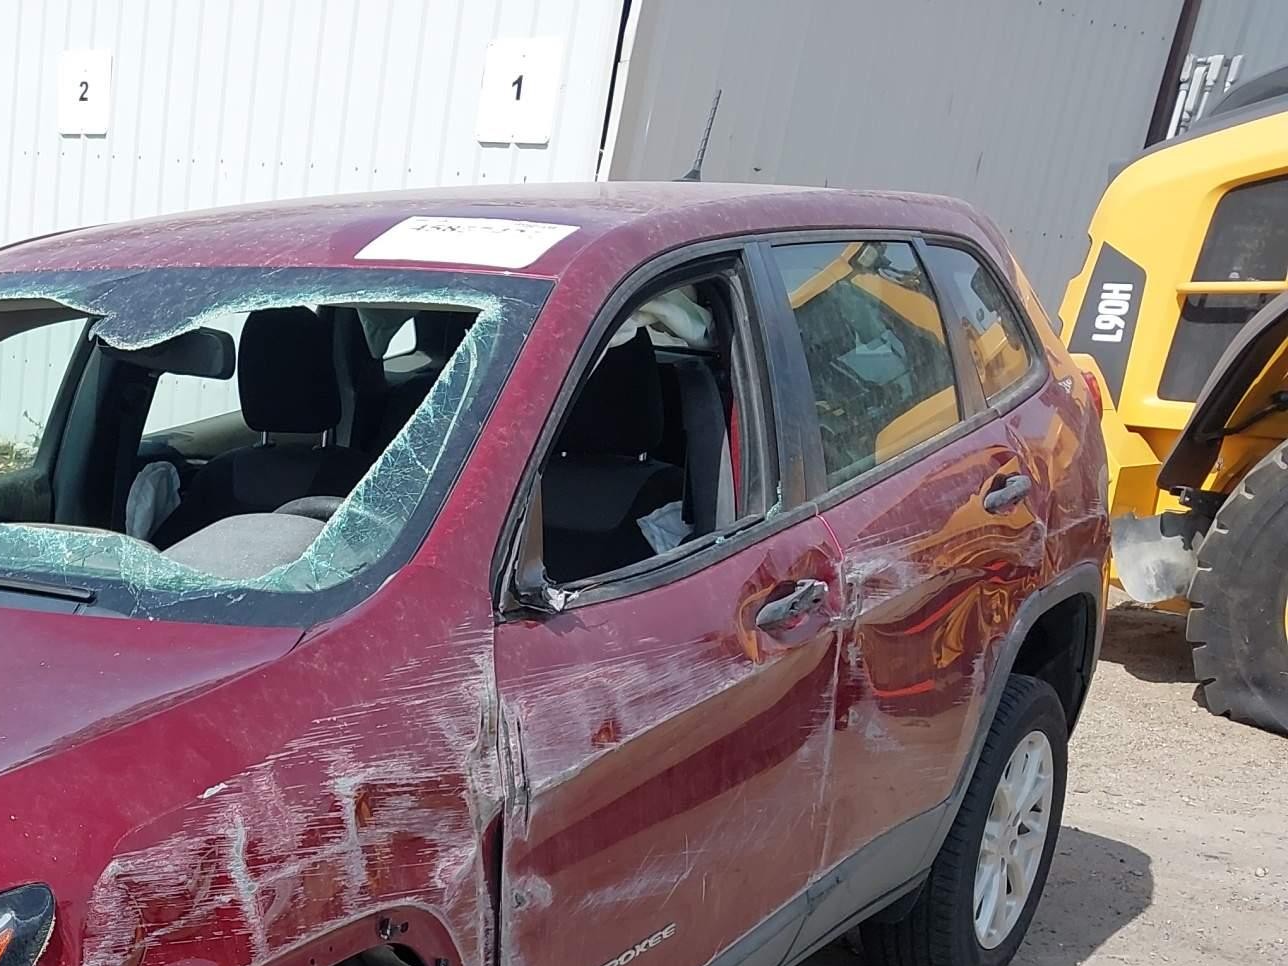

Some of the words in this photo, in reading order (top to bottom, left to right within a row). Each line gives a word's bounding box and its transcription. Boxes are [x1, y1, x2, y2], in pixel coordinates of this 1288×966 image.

[79, 81, 89, 102] 2
[512, 74, 523, 101] 1
[1091, 282, 1133, 343] L90H
